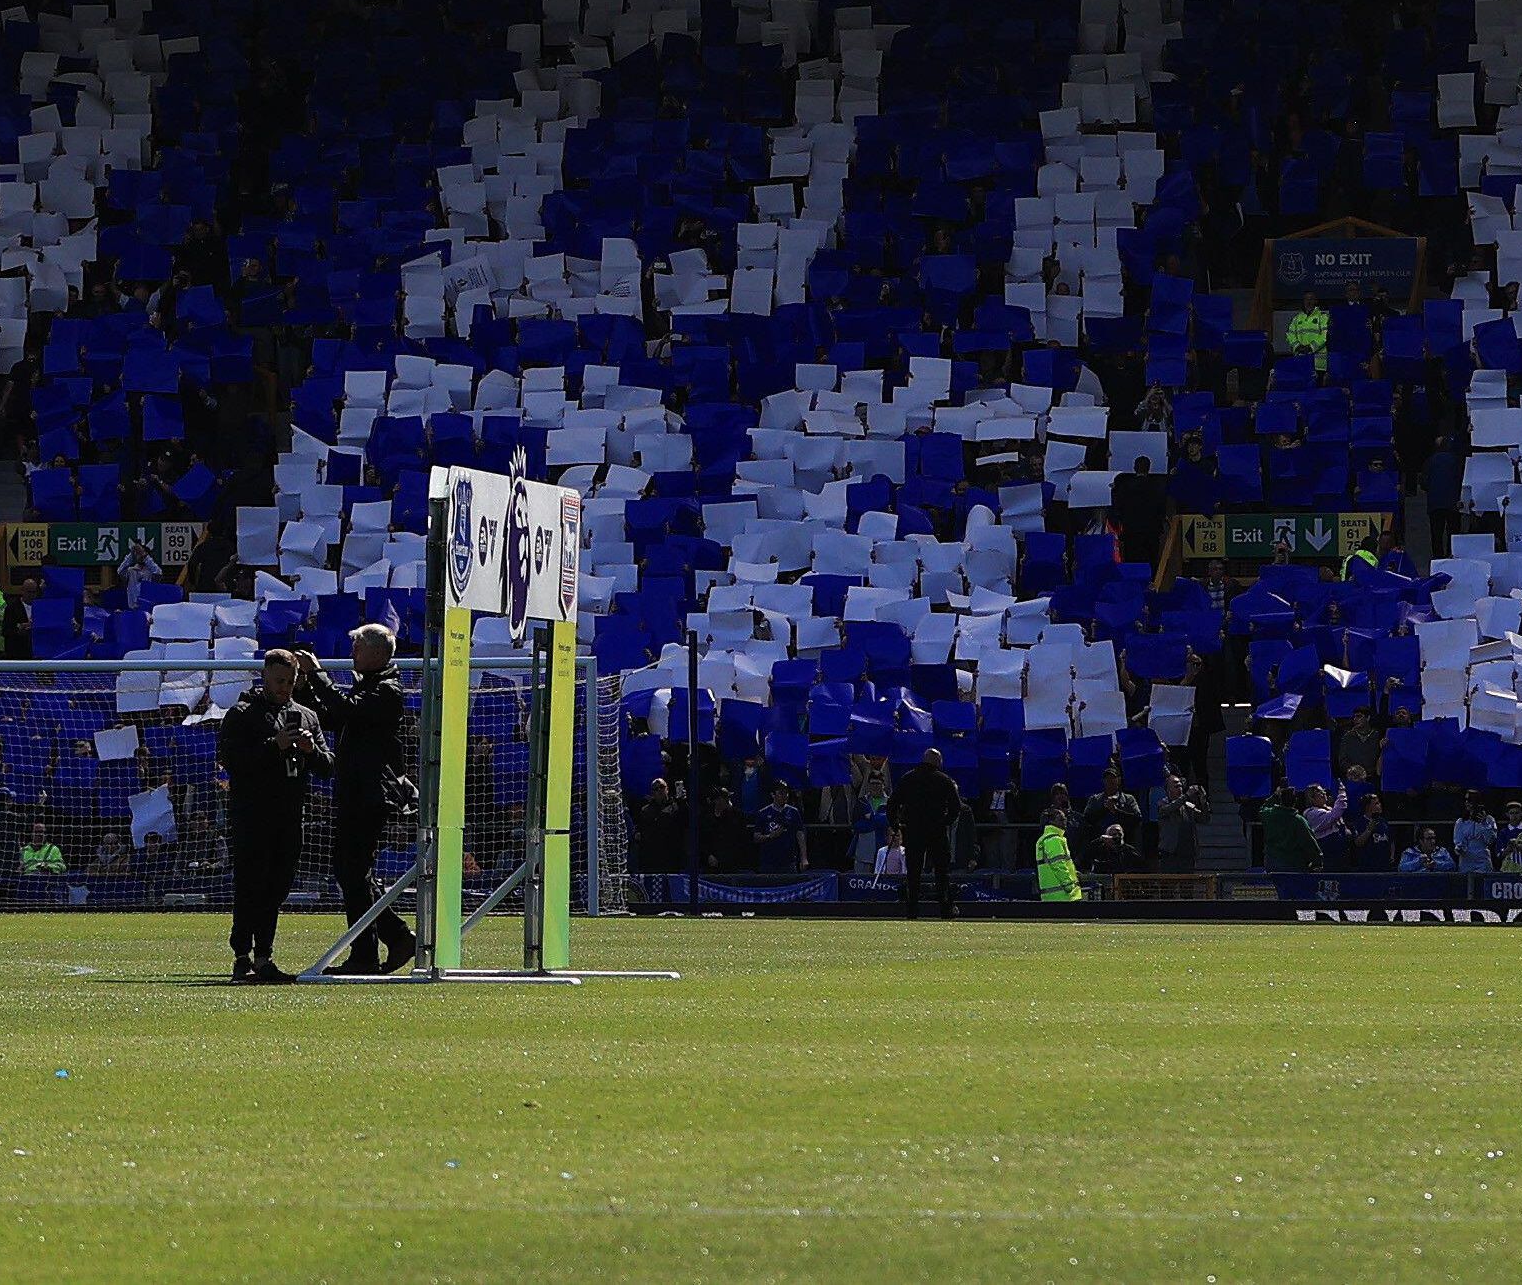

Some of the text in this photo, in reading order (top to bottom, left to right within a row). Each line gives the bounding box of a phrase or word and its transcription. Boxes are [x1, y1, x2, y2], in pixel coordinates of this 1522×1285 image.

[1315, 253, 1372, 266] NO EXIT
[1341, 519, 1367, 527] SEATS
[165, 526, 190, 534] SEATS
[1346, 529, 1359, 539] 61
[1232, 528, 1264, 543] Exit
[22, 539, 43, 549] 106
[57, 537, 88, 551] Exit
[168, 536, 185, 547] 89
[166, 551, 189, 561] 105
